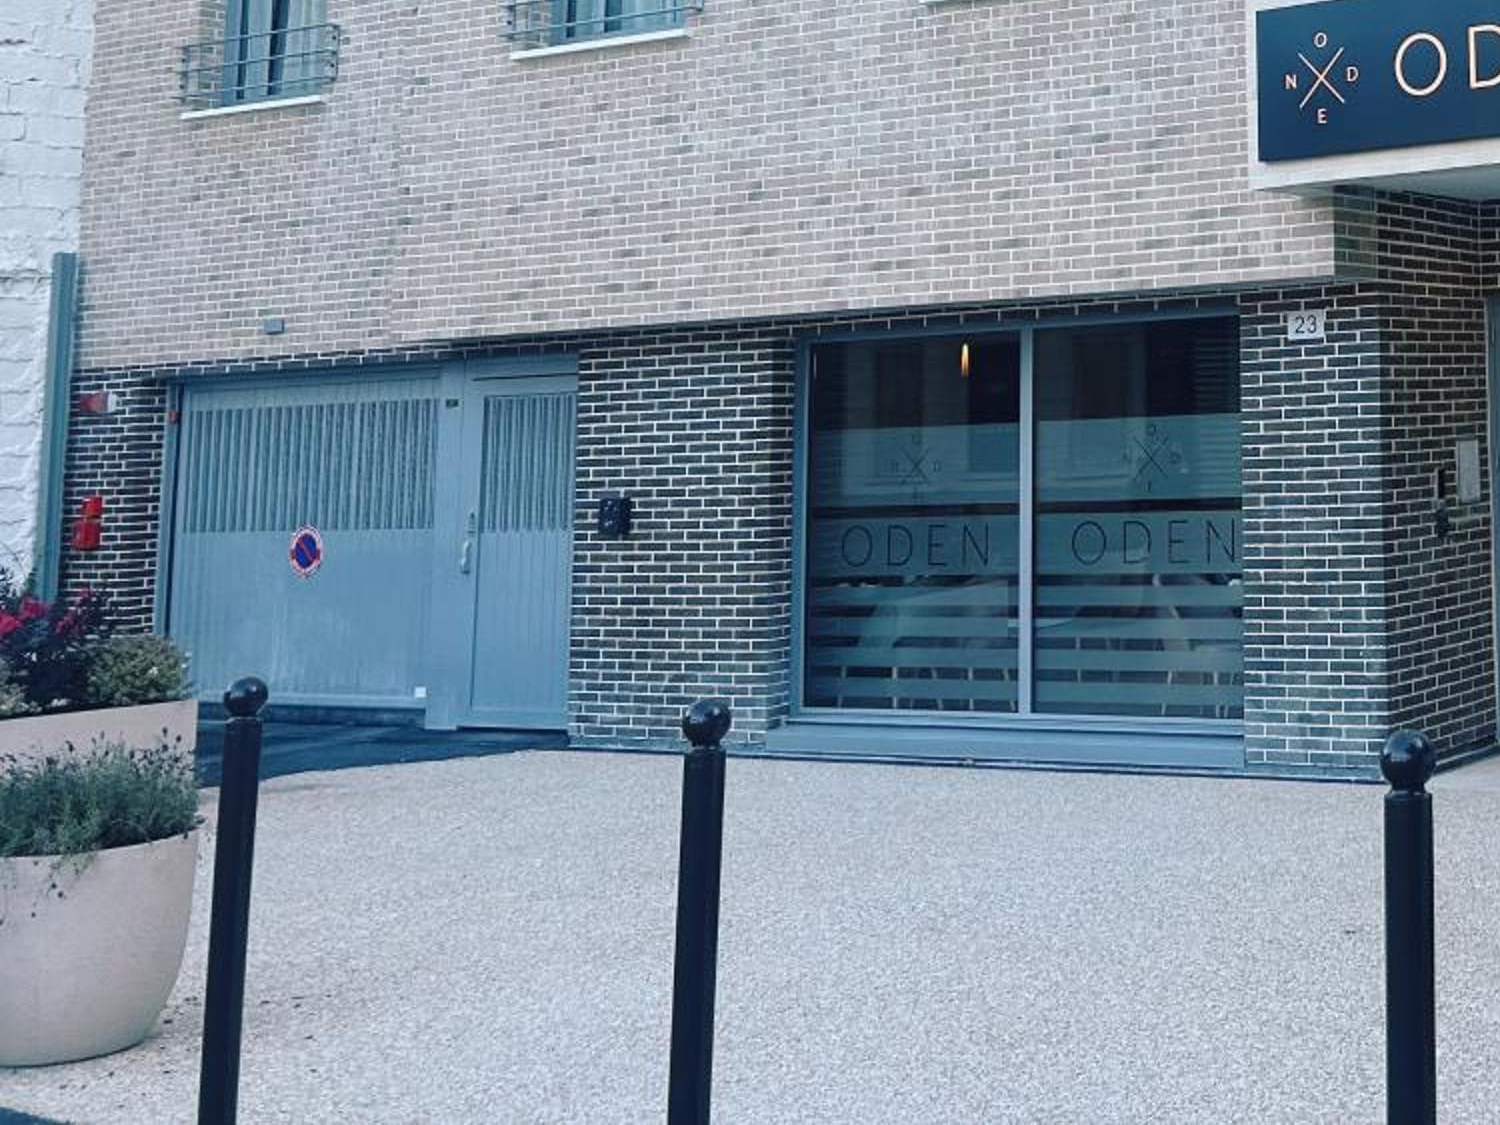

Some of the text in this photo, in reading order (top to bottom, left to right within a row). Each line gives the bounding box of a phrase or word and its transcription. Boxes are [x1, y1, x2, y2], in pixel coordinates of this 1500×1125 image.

[1285, 74, 1297, 90] N
[1347, 66, 1359, 82] D
[1317, 108, 1328, 124] E
[1295, 315, 1317, 334] 23
[841, 523, 989, 567] ODEN
[1071, 518, 1236, 566] ODEN
